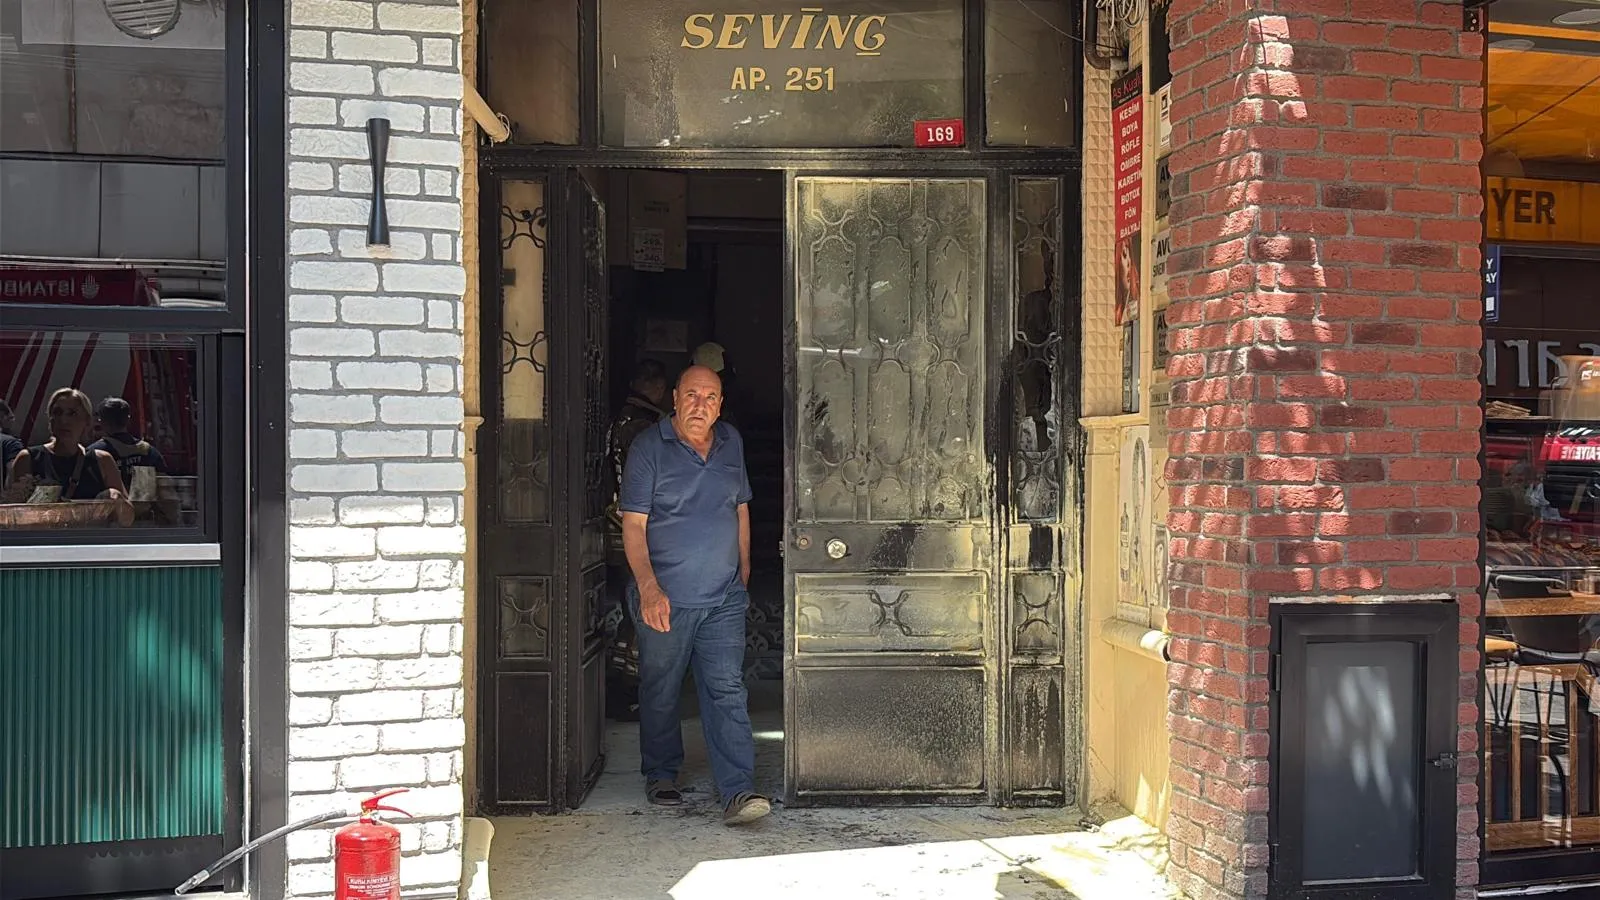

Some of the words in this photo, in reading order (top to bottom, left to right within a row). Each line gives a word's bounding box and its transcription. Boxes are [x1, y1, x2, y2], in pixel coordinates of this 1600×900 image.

[731, 67, 770, 91] AP.
[785, 67, 834, 91] 251
[927, 126, 954, 142] 169
[1121, 121, 1138, 138] BOYA
[1120, 152, 1141, 172] OMBRE
[1120, 187, 1140, 206] BOTOX
[1491, 188, 1556, 224] YER
[1120, 221, 1140, 239] BALYAJ
